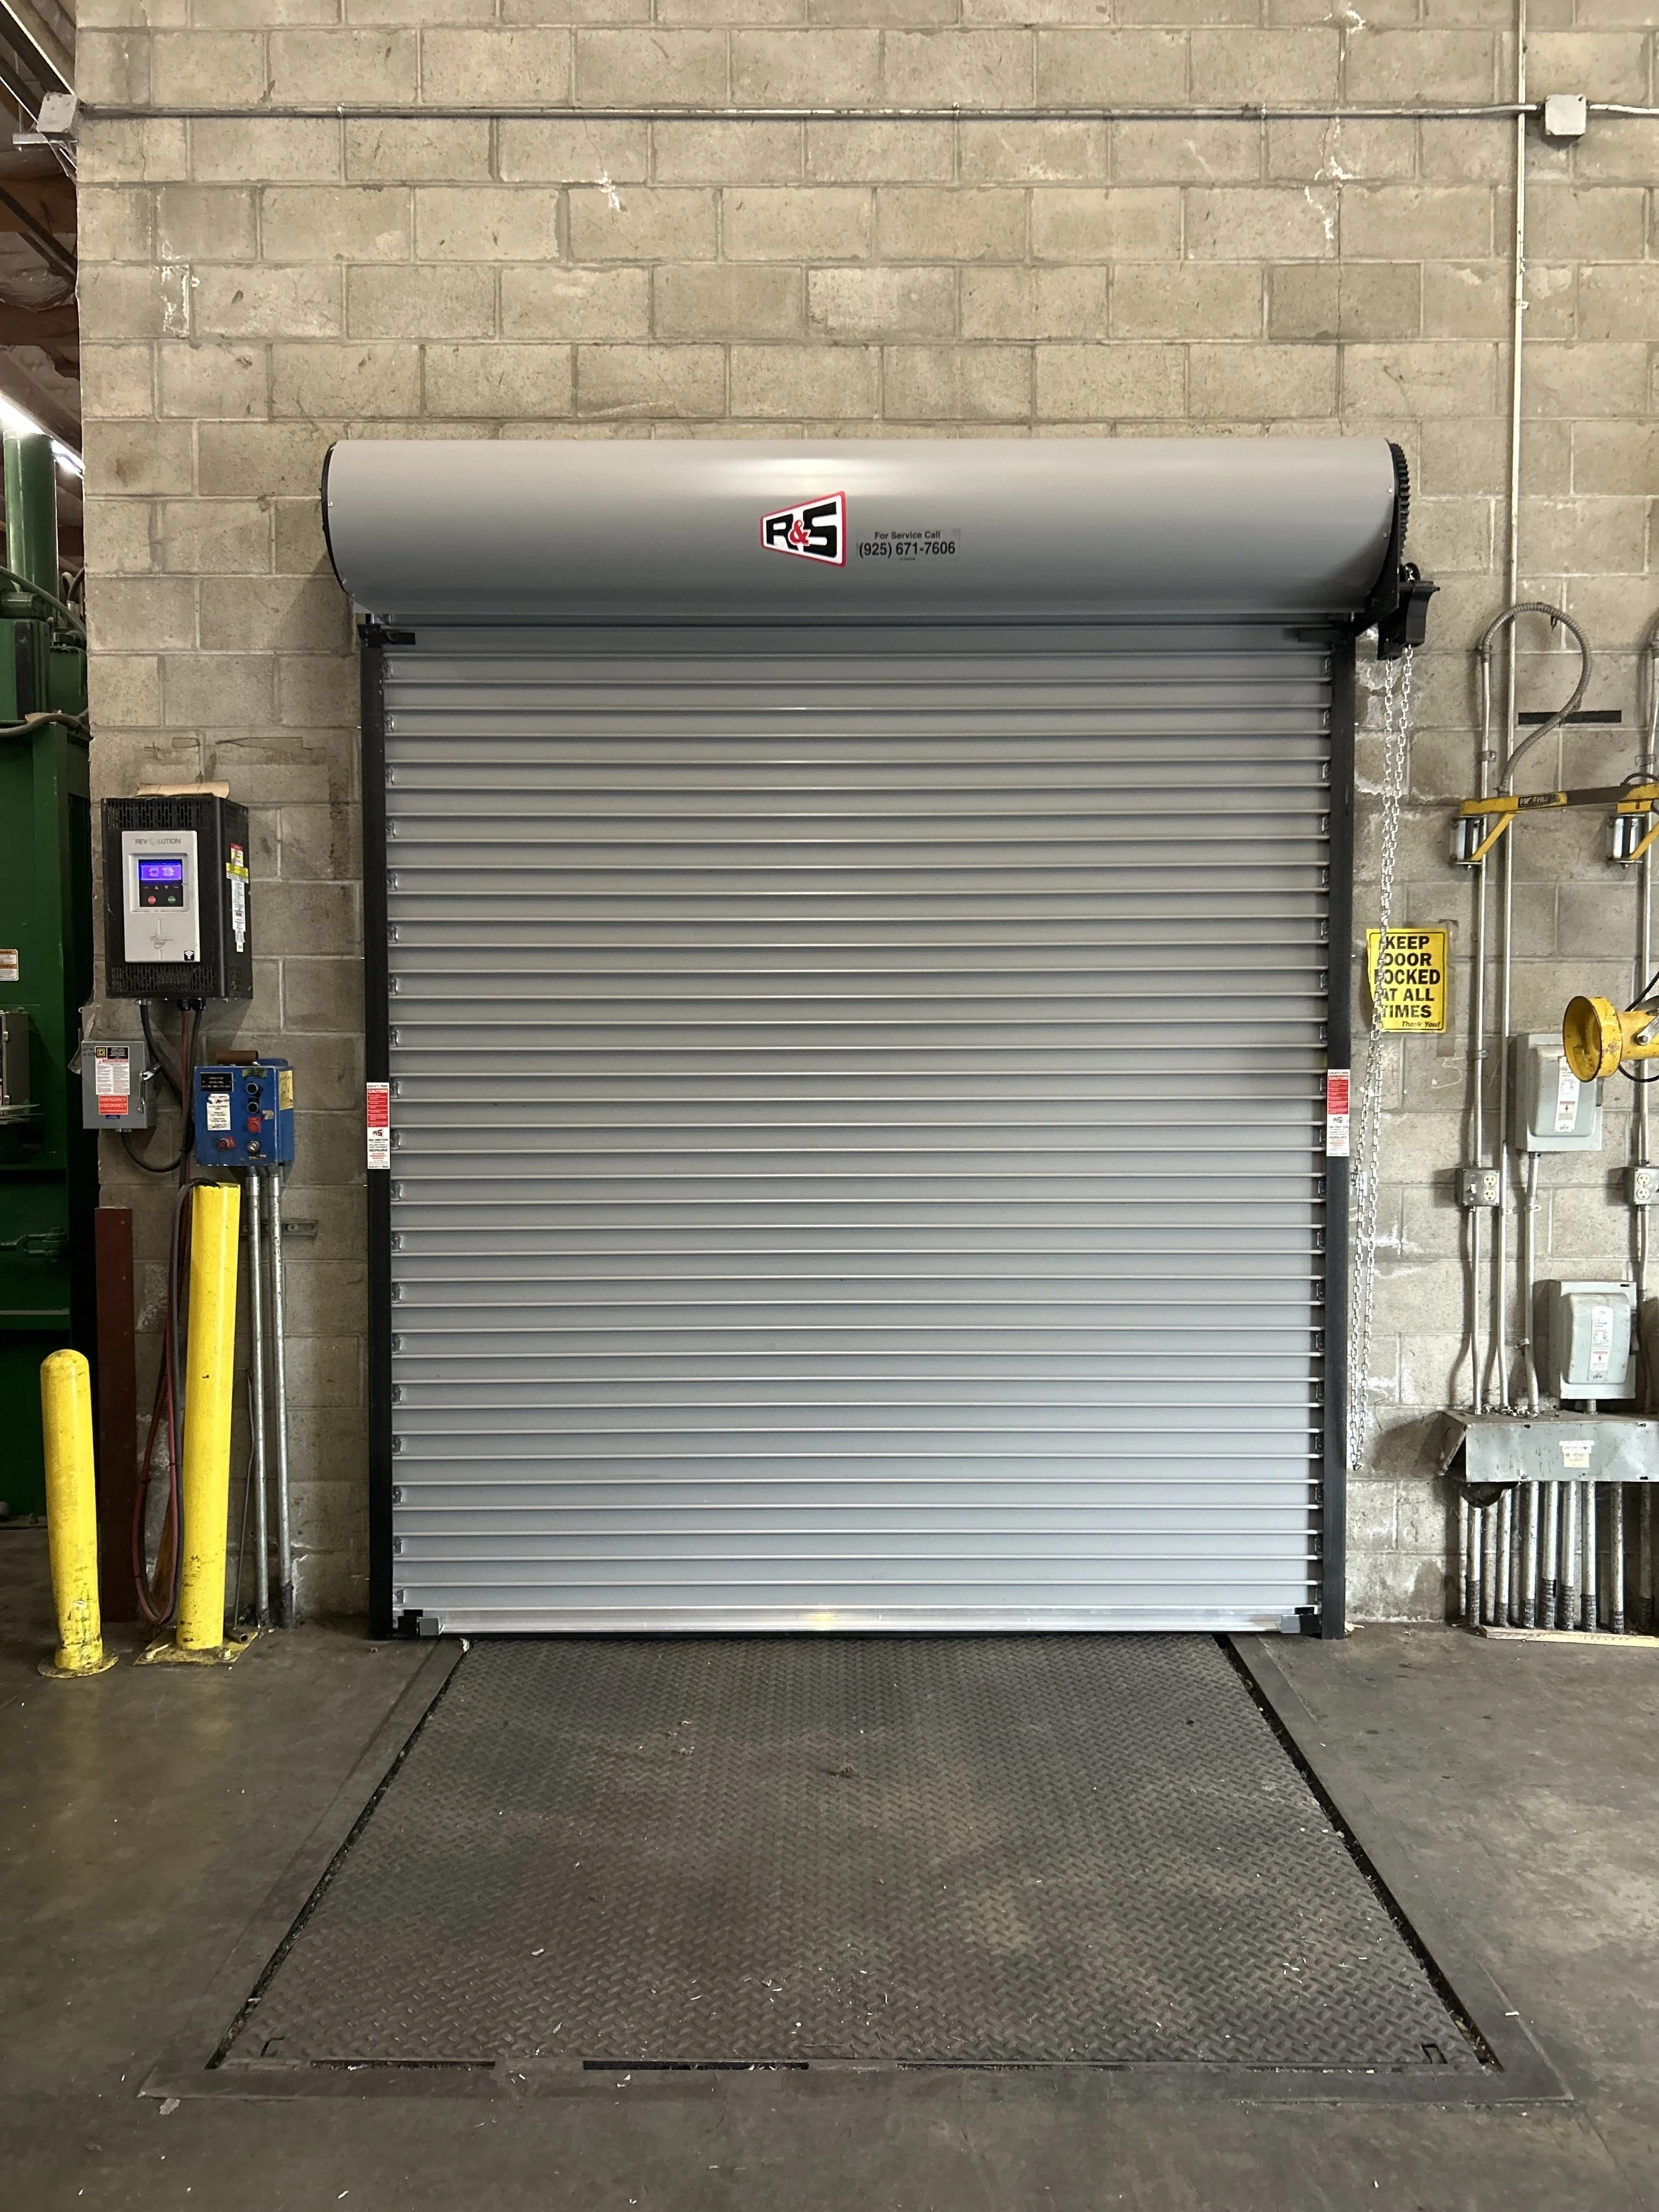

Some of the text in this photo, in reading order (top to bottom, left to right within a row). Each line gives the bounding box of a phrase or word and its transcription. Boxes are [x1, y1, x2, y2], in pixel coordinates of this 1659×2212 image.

[891, 531, 922, 540] Service
[859, 541, 956, 558] (925) 671-7606
[1384, 936, 1429, 949] KEEP
[1403, 988, 1435, 1001] ALL
